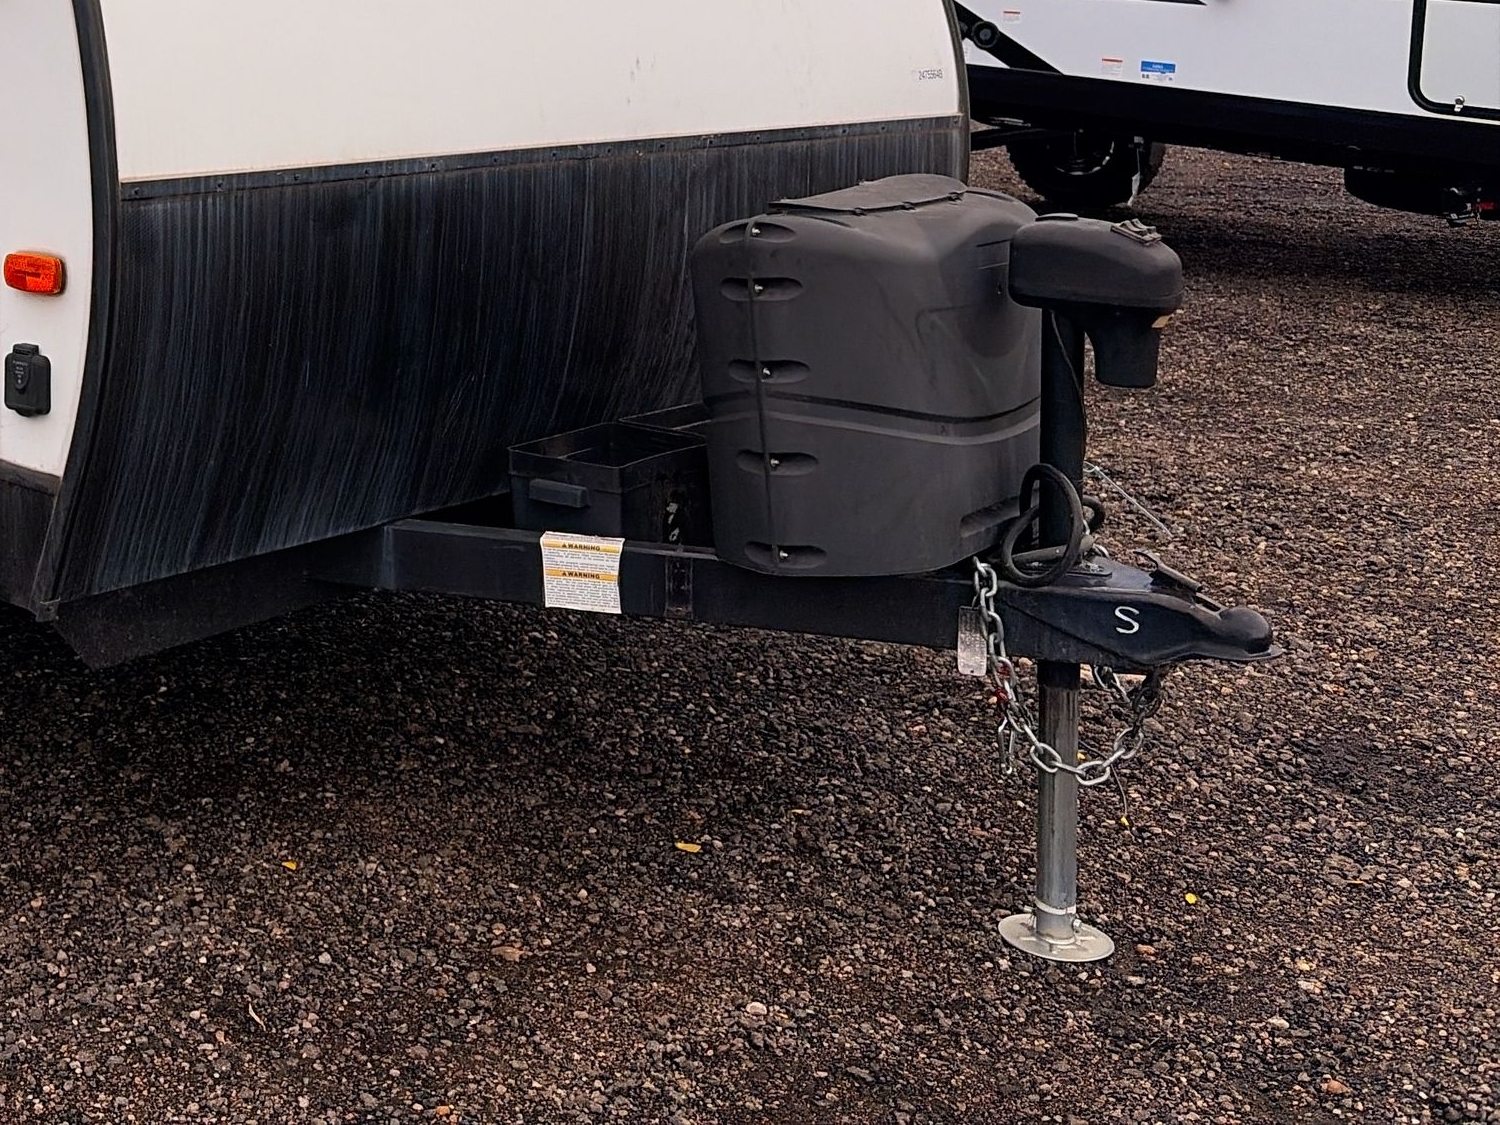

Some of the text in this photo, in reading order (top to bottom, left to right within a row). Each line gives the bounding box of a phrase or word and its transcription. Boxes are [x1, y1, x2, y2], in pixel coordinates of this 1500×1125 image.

[567, 543, 601, 552] WARNING
[567, 572, 601, 580] WARNING
[1114, 606, 1139, 634] S
